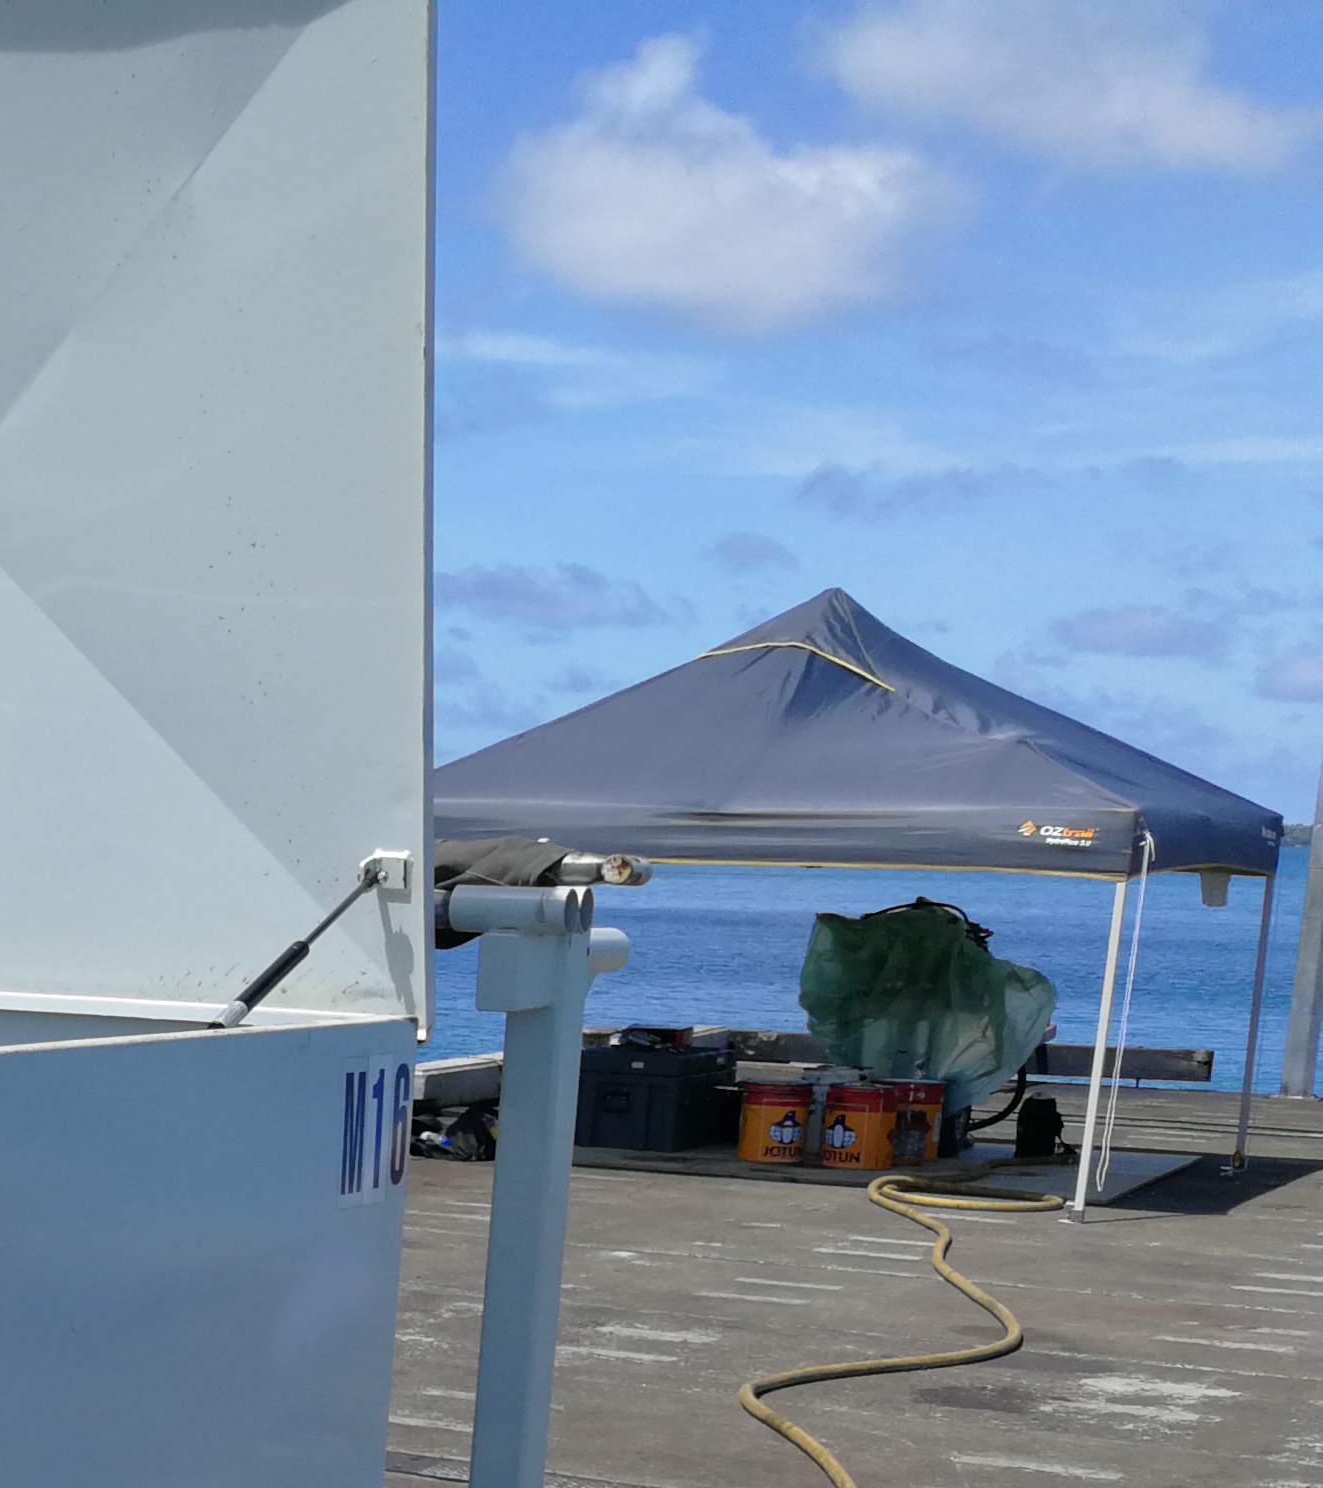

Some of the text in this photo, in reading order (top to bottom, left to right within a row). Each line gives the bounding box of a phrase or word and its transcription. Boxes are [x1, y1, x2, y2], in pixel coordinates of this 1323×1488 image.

[341, 1063, 410, 1195] M16
[763, 1146, 804, 1158] JOTU
[823, 1150, 861, 1163] OTUN
